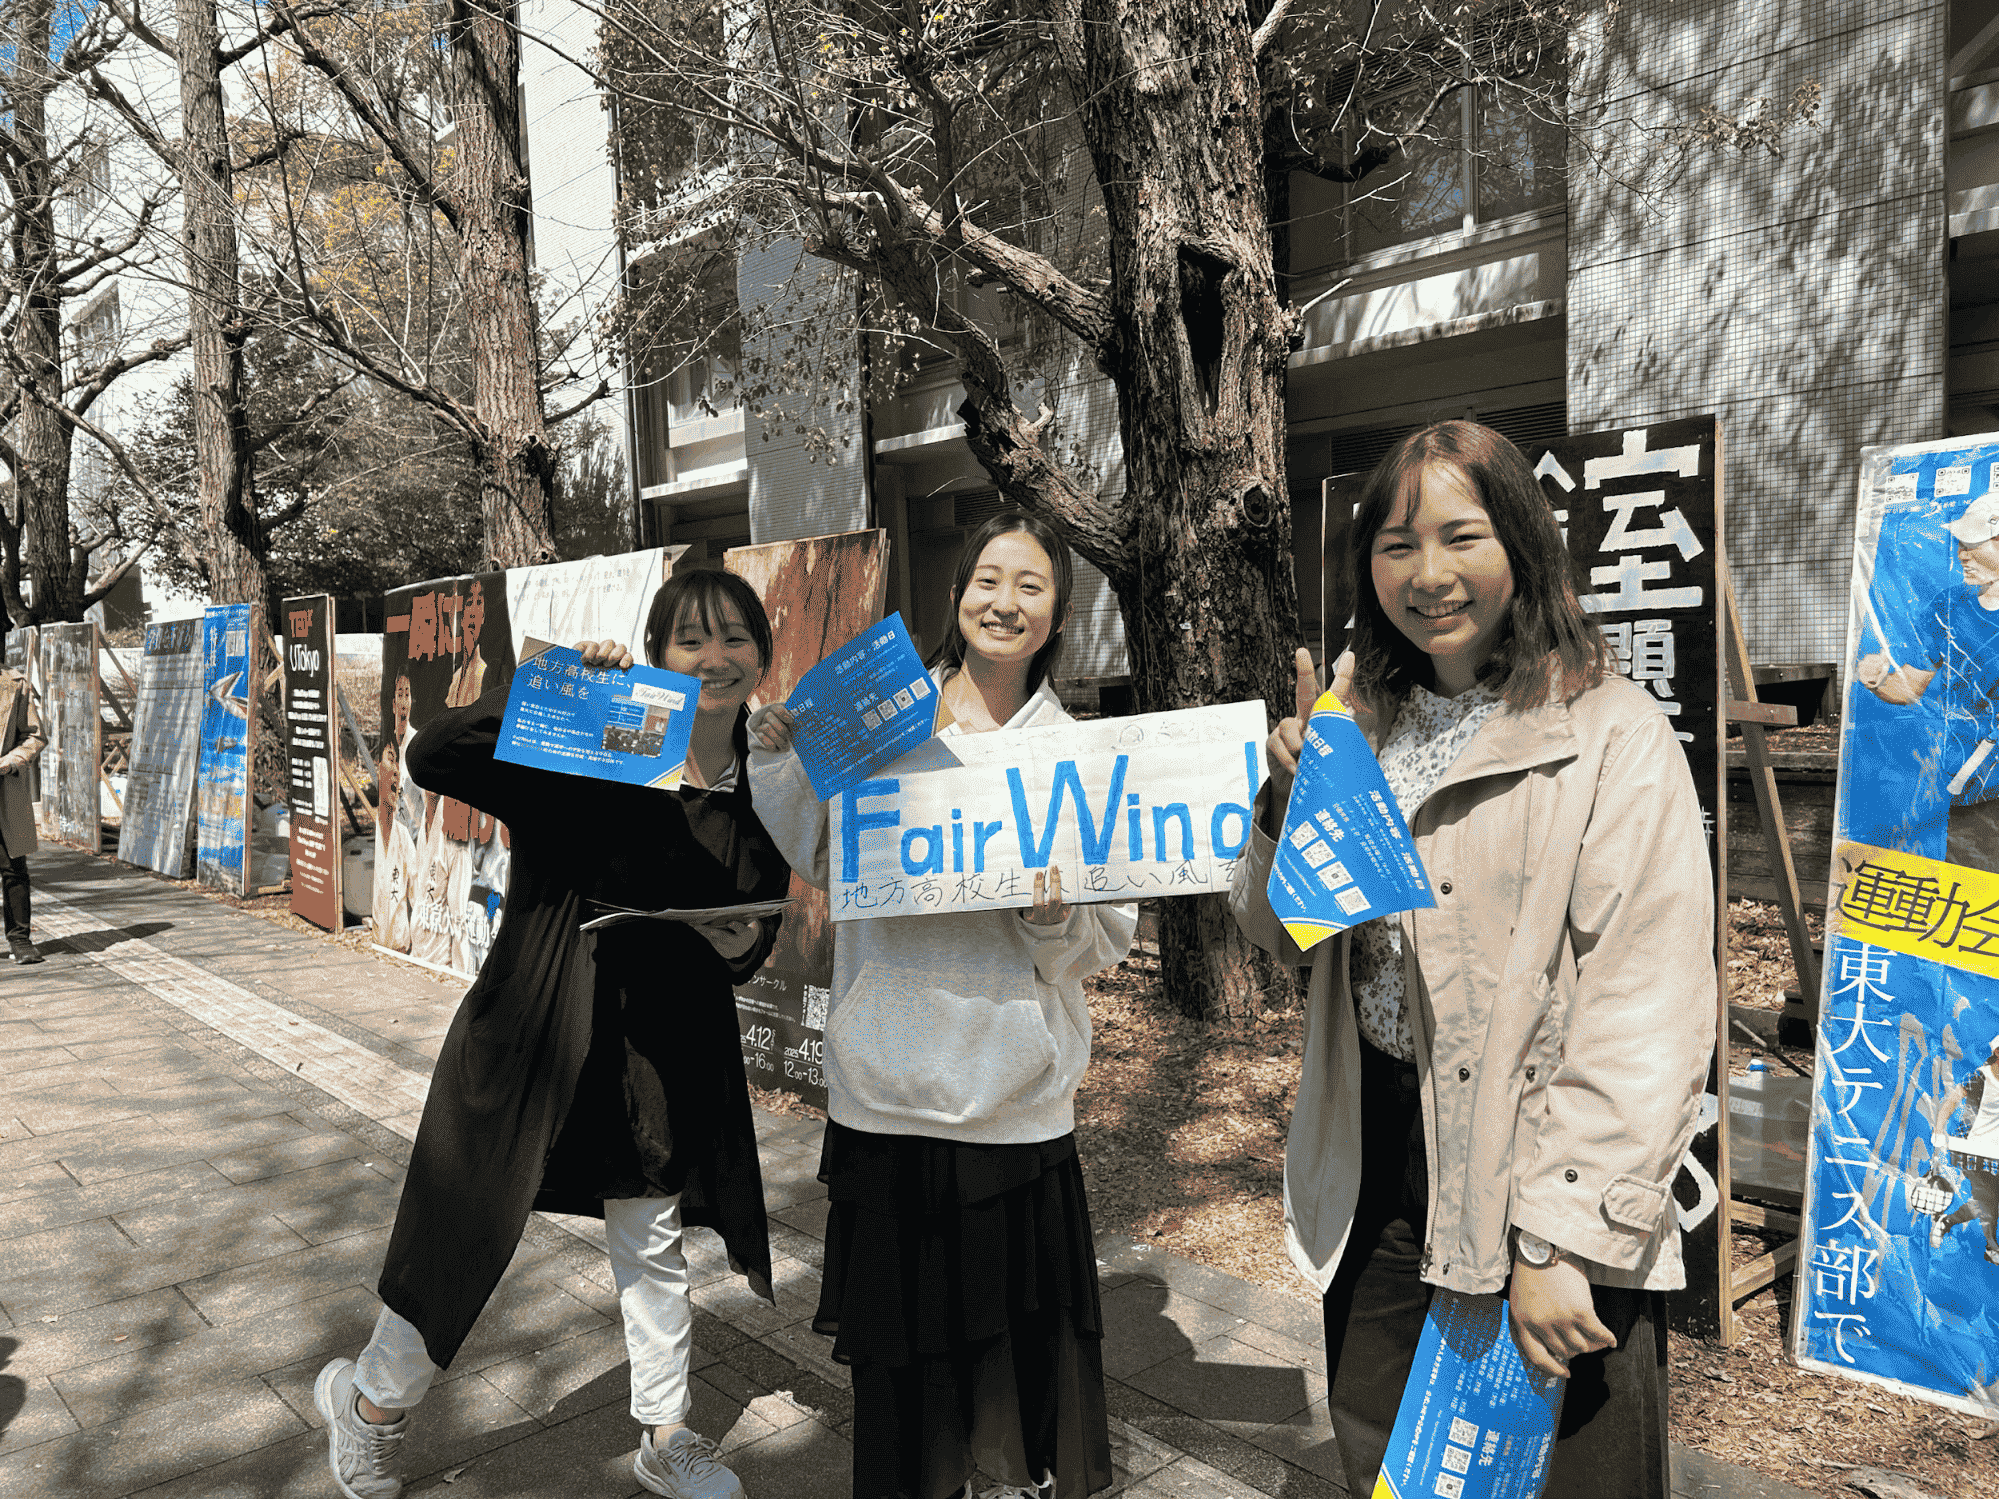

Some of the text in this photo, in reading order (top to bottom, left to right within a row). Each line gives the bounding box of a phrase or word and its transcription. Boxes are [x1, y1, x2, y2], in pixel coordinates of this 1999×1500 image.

[289, 644, 320, 678] UTokyo
[532, 656, 631, 690] 地方高校生に、
[527, 673, 590, 700] 追い風を
[1313, 808, 1346, 843] 連絡先
[746, 1024, 773, 1051] 4.12
[1812, 943, 1898, 1364] 東大テニス部で
